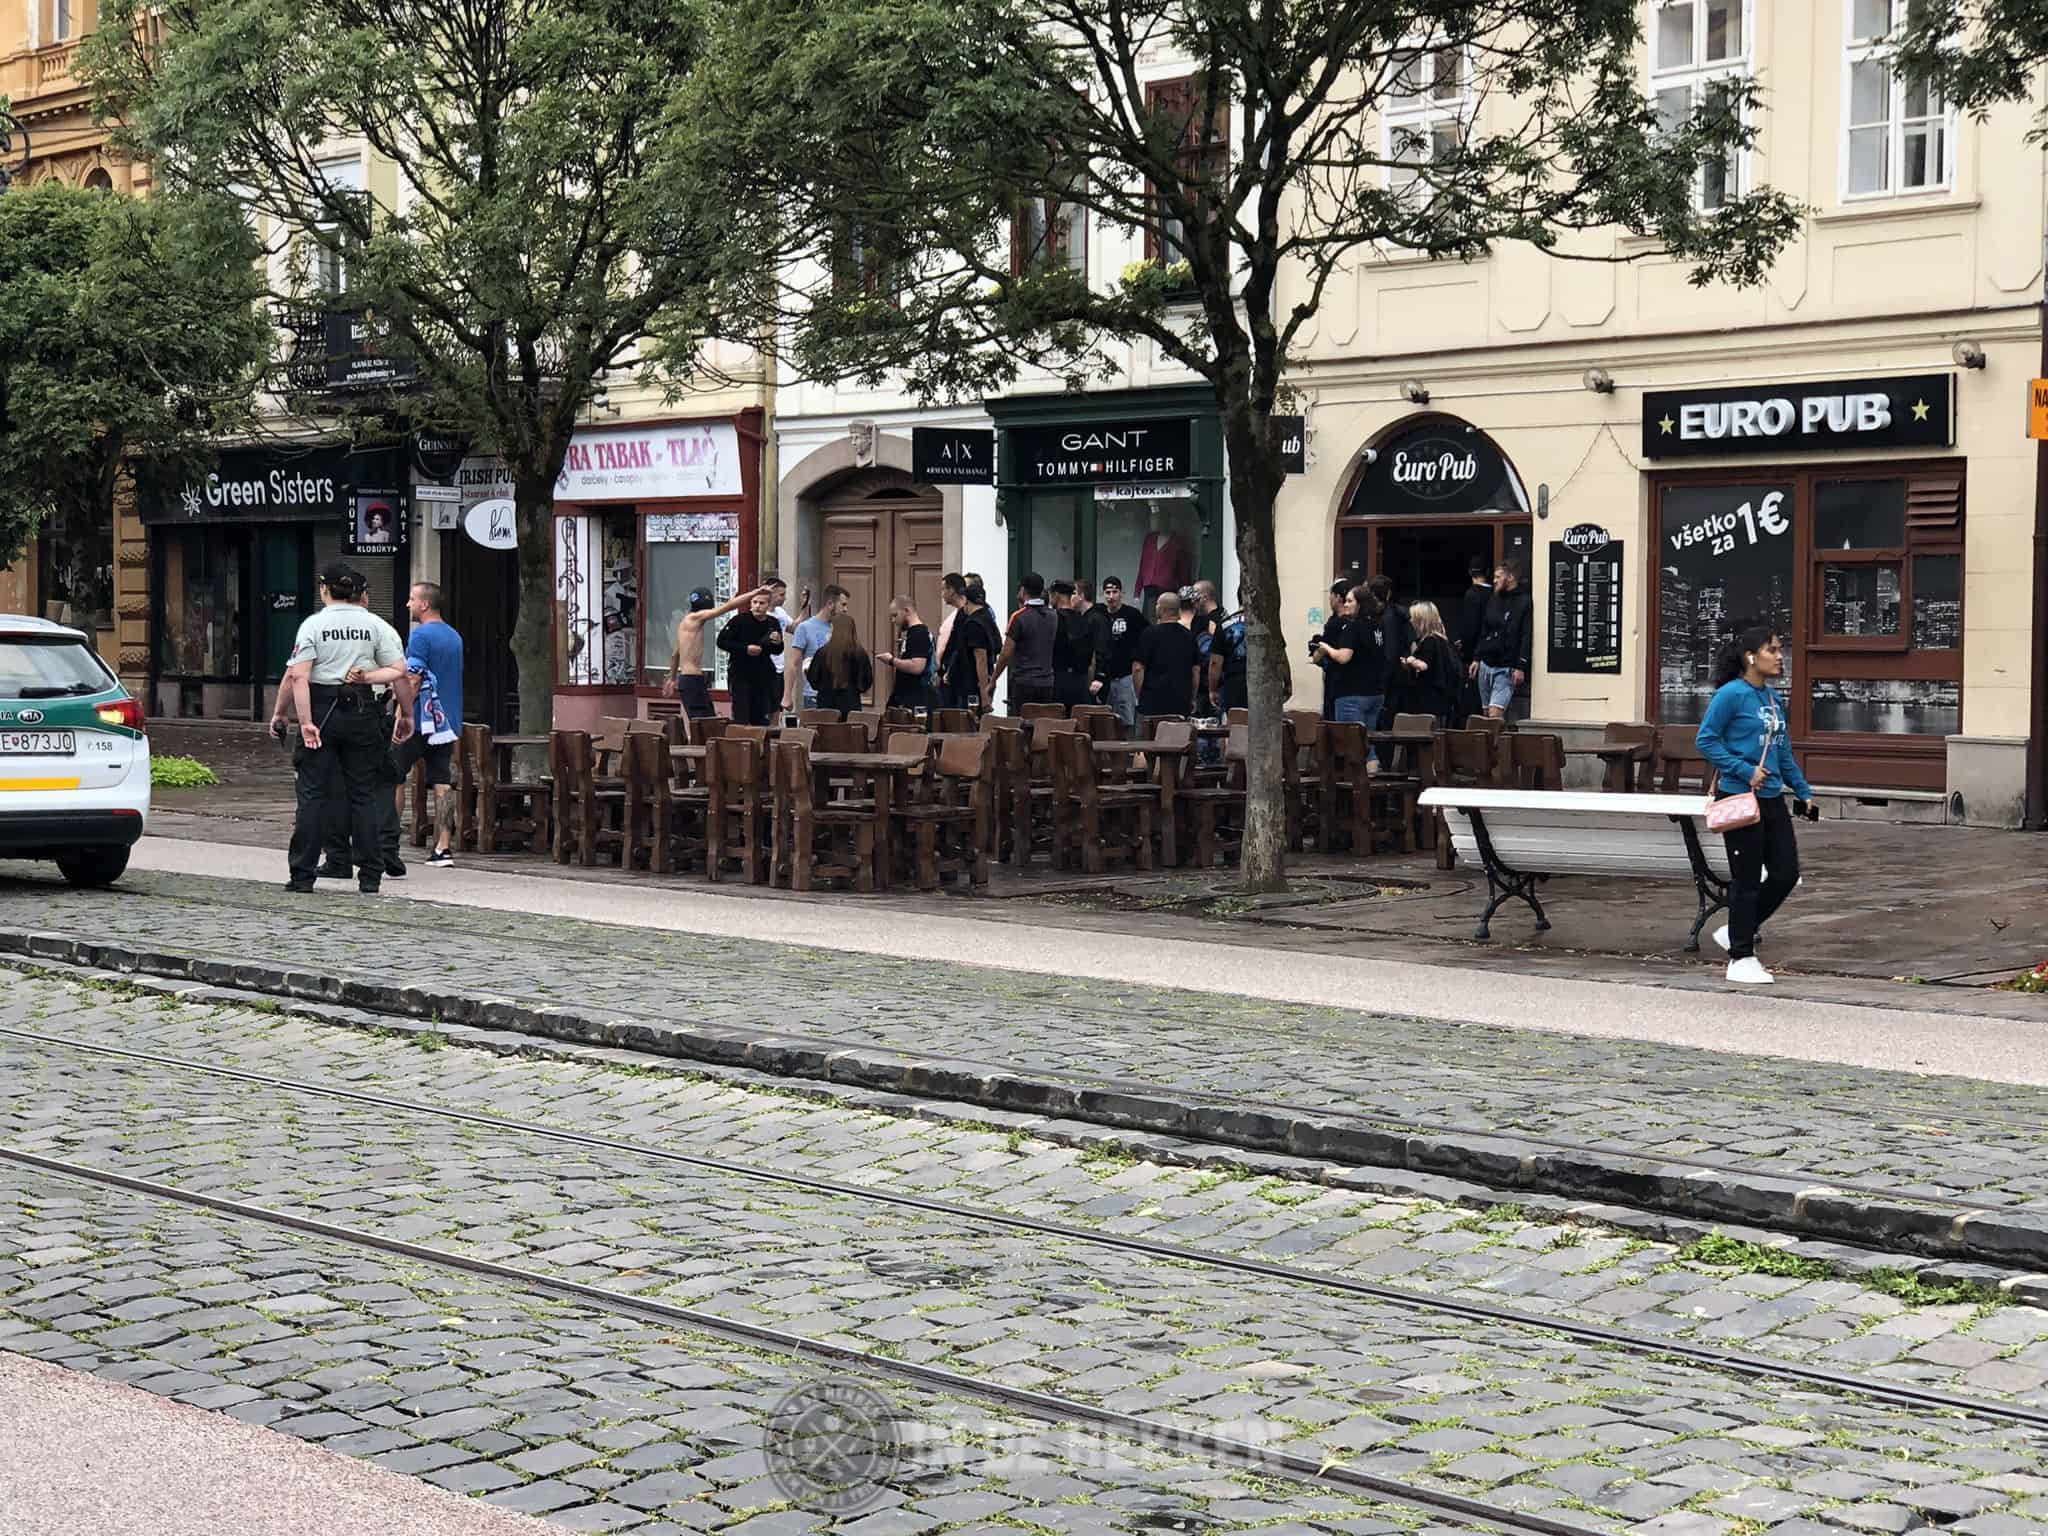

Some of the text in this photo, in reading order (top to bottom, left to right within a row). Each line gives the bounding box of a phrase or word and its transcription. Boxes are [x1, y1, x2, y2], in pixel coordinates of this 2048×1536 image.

[1679, 393, 1892, 441] EURO PUB
[1061, 430, 1149, 451] GANT
[1281, 434, 1301, 454] ub
[567, 443, 593, 472] RA
[594, 437, 654, 469] TABAK
[459, 467, 515, 485] IRISH PU
[1036, 457, 1175, 477] TOMMY HILFIGER
[1392, 451, 1477, 482] Euro Pub
[205, 469, 335, 507] Green Sisters
[1736, 490, 1790, 546] 1€
[1564, 528, 1609, 546] Euro Pub
[1670, 512, 1737, 551] všetko
[1711, 532, 1736, 556] za
[321, 625, 372, 642] POLÍCIA
[95, 741, 113, 752] 158
